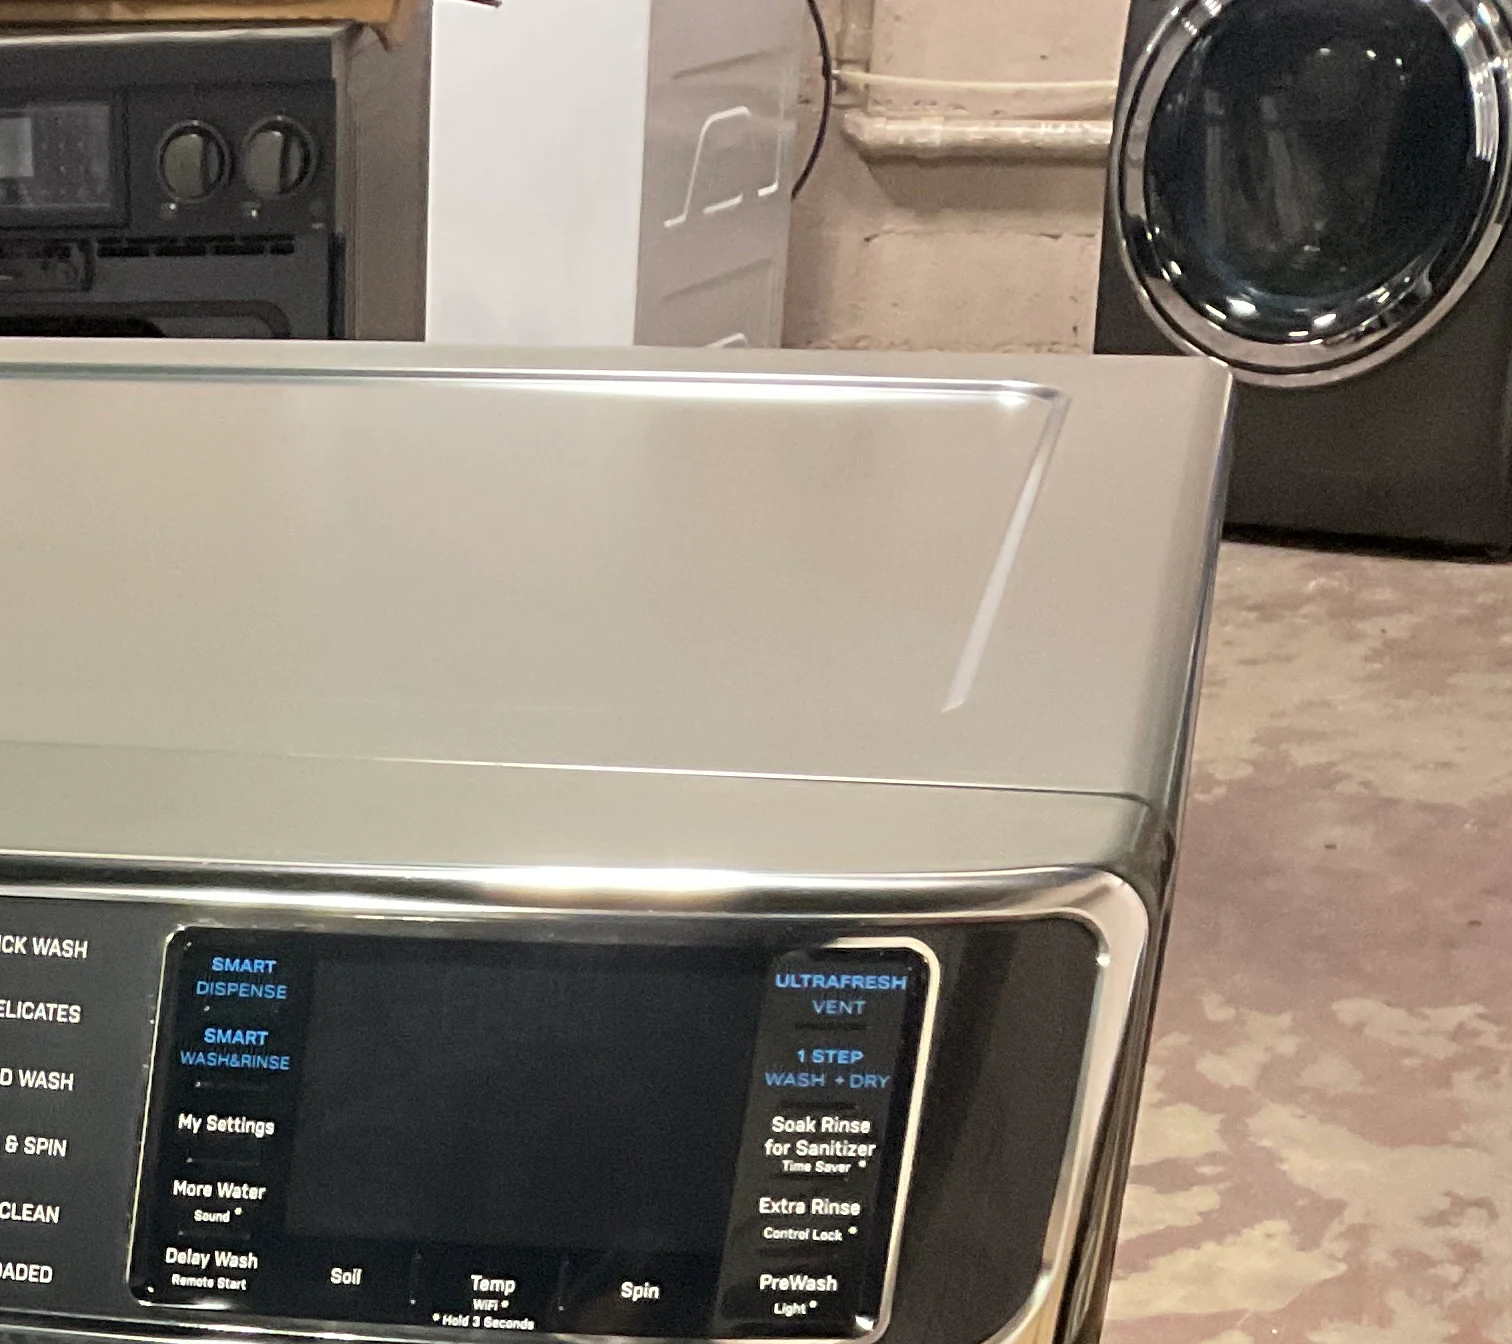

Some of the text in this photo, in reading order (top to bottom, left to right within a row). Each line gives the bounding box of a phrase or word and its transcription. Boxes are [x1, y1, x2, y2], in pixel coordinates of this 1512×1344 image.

[32, 936, 89, 959] WASH
[211, 956, 277, 974] SMART
[196, 980, 287, 1001] DISPENSE
[774, 973, 908, 991] ULTRAFRESH
[811, 1000, 867, 1016] VENT
[203, 1028, 269, 1046] SMART
[180, 1050, 290, 1071] WASH&RINSE
[797, 1049, 864, 1065] 1 STEP
[18, 1068, 75, 1091] WASH
[764, 1072, 825, 1087] WASH
[849, 1074, 890, 1089] DRY
[178, 1112, 275, 1138] My Settings
[771, 1116, 871, 1135] Soak Rinse
[5, 1133, 19, 1153] &
[23, 1135, 67, 1157] SPIN
[764, 1138, 877, 1158] for Sanitizer
[782, 1159, 851, 1174] Time Saver
[173, 1179, 267, 1201] More Water
[193, 1208, 230, 1223] Sound
[758, 1197, 861, 1217] Extra Rinse
[763, 1226, 843, 1243] Control Lock
[165, 1246, 258, 1270] Delay Wash
[171, 1273, 247, 1292] Remote Start
[330, 1266, 363, 1287] Soil
[470, 1274, 517, 1296] Temp
[758, 1274, 838, 1293] PreWash
[620, 1281, 660, 1302] Spin
[773, 1300, 807, 1318] Light
[442, 1313, 535, 1331] Hold 3 Seconds
